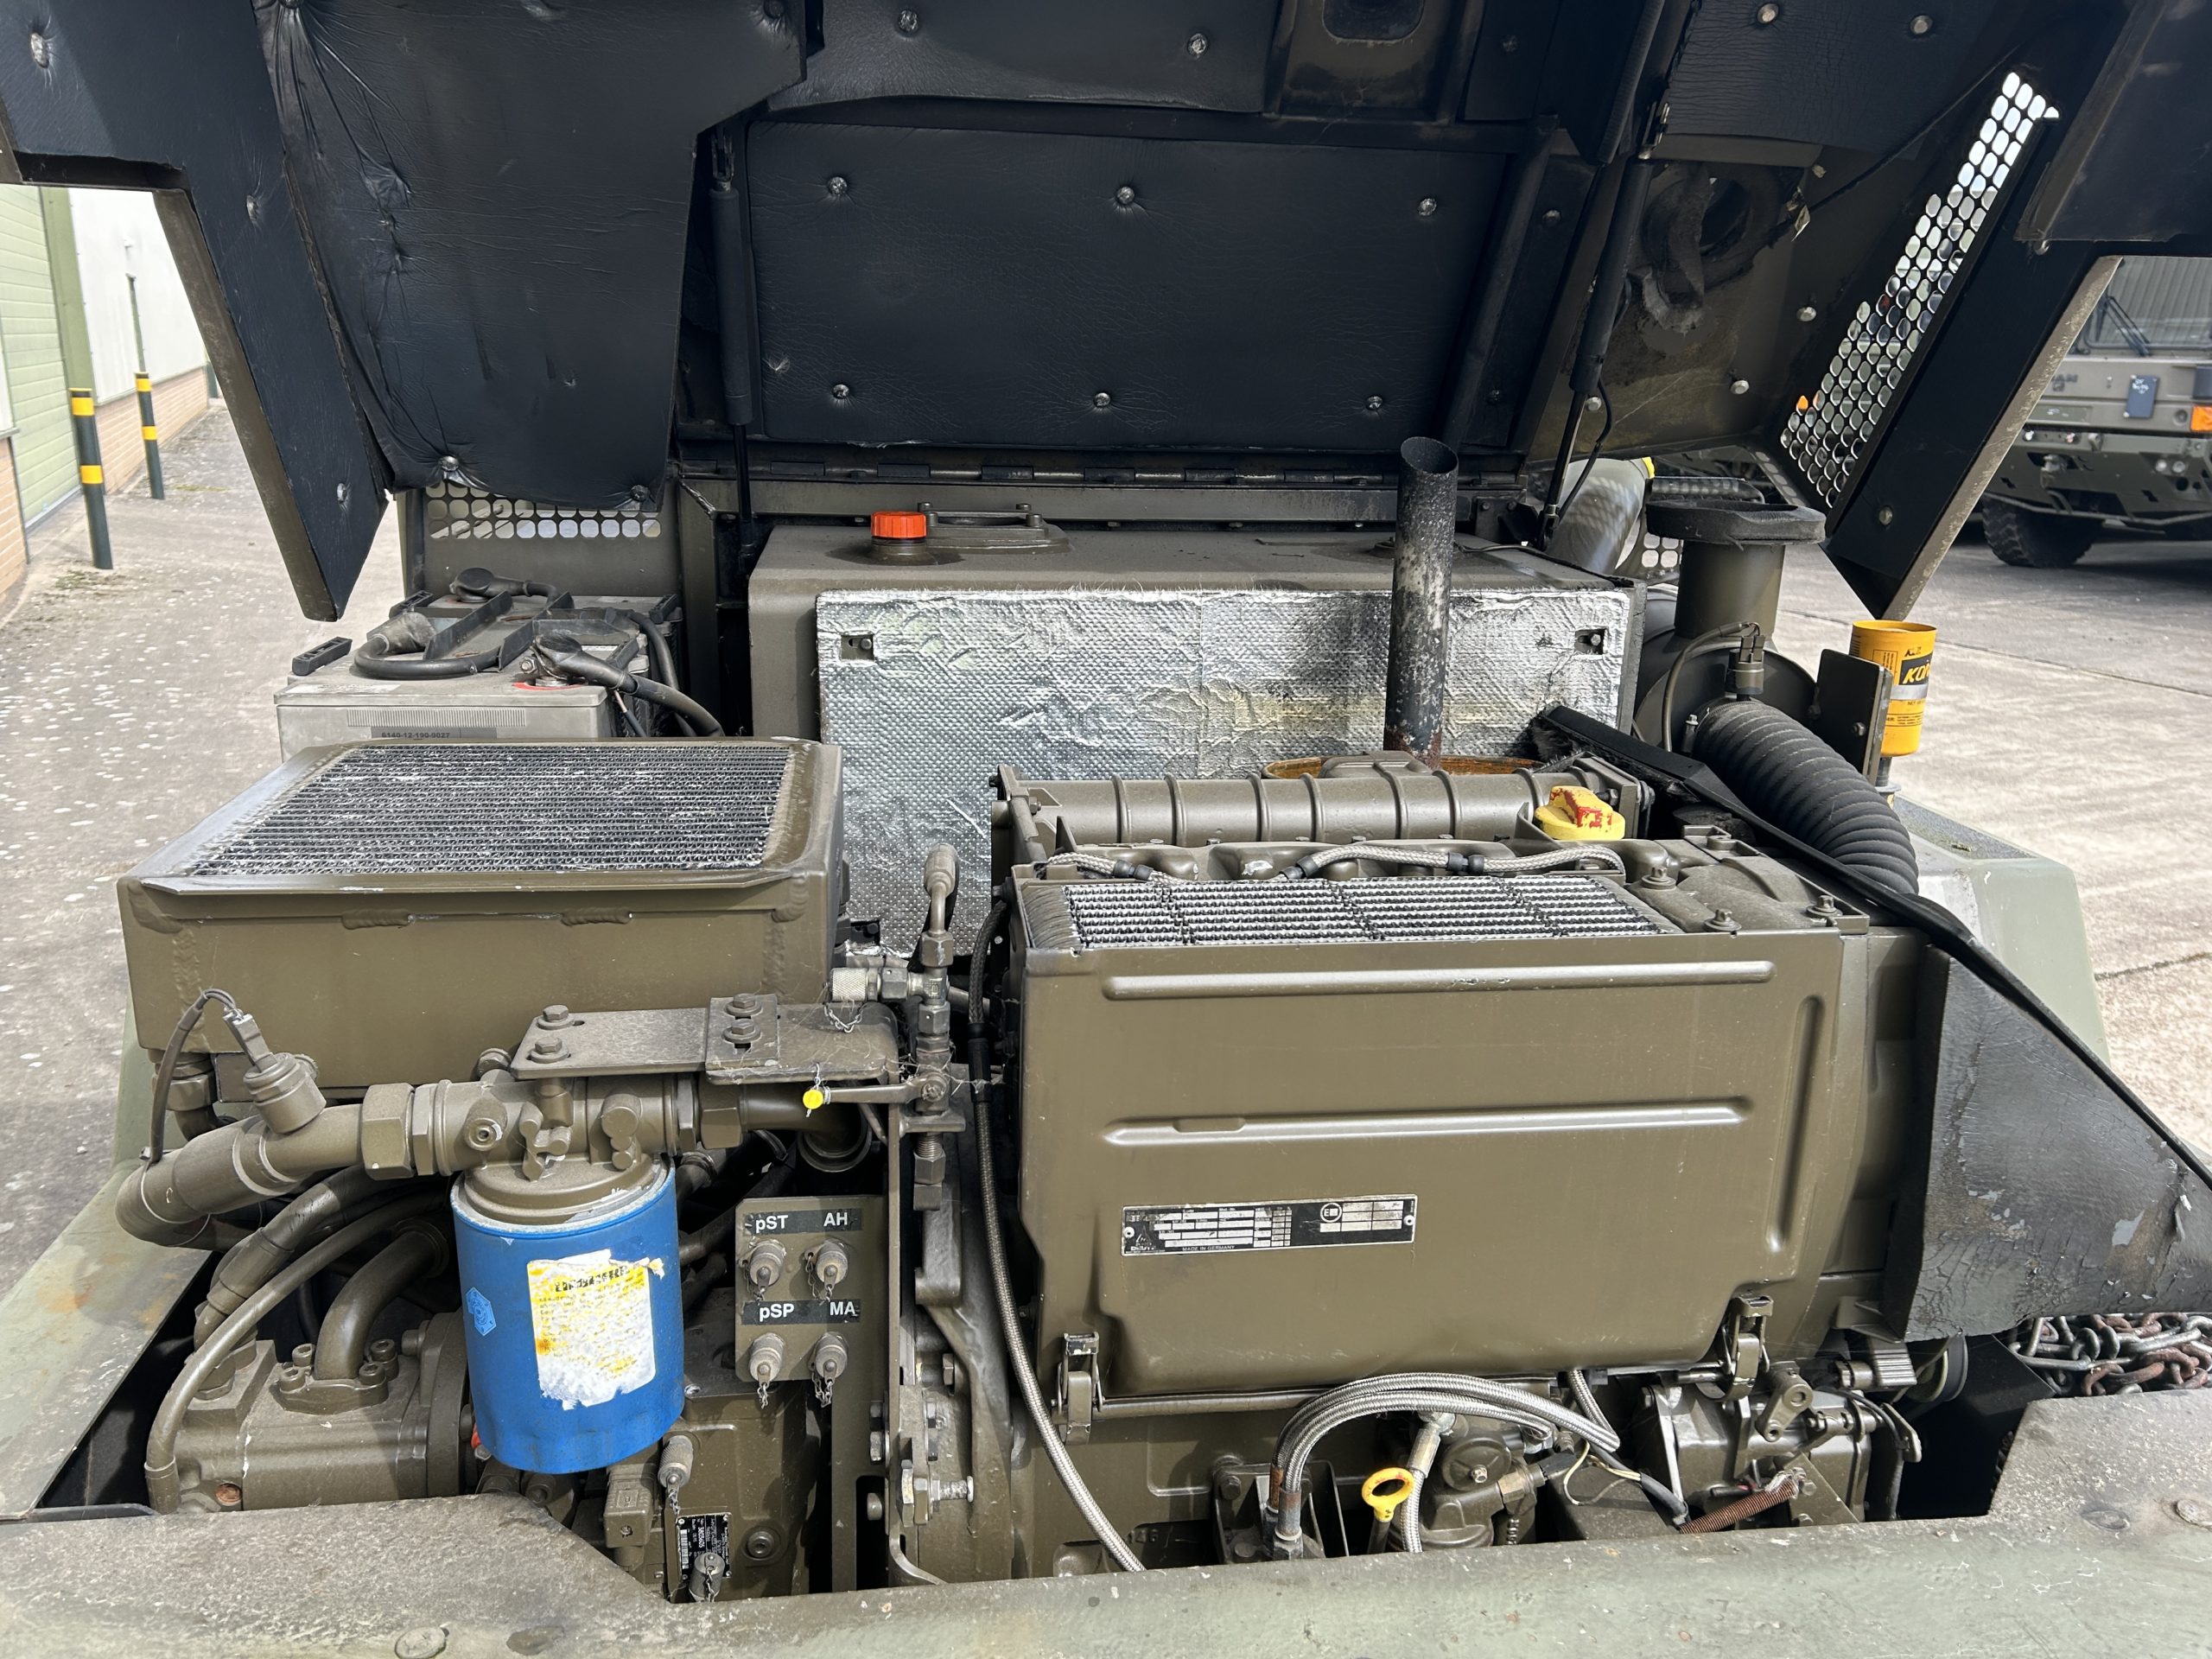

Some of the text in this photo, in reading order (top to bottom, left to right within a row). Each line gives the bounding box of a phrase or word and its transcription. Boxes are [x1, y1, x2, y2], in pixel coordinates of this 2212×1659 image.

[755, 1211, 848, 1234] pST AH
[759, 1300, 855, 1322] pSP MA
